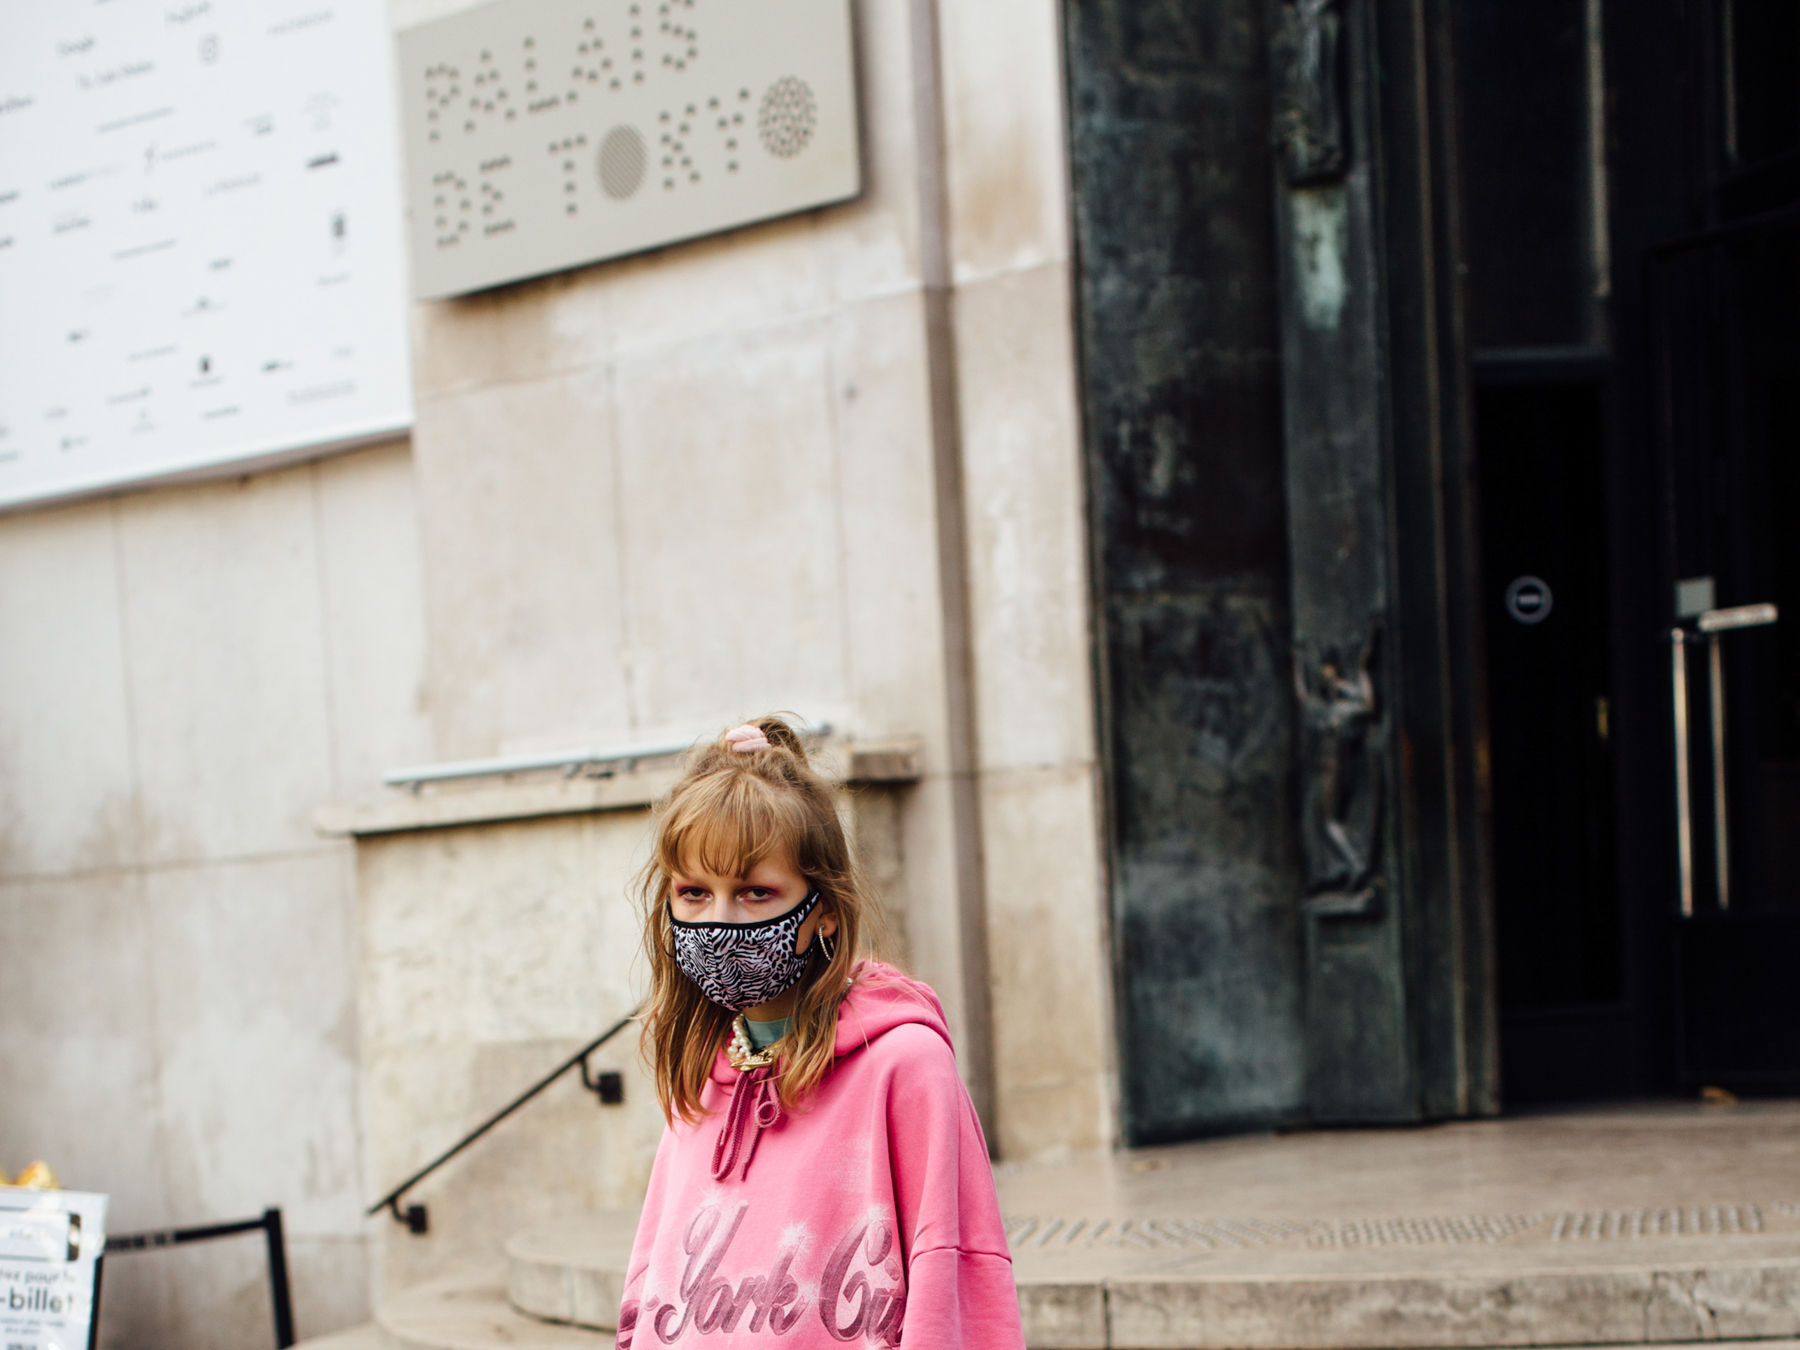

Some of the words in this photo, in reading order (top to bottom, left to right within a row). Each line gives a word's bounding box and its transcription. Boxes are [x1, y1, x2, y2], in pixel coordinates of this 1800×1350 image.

[425, 0, 698, 142] PALAIS
[432, 155, 517, 249] DE
[547, 74, 818, 217] TOKYO
[653, 1199, 812, 1346] York
